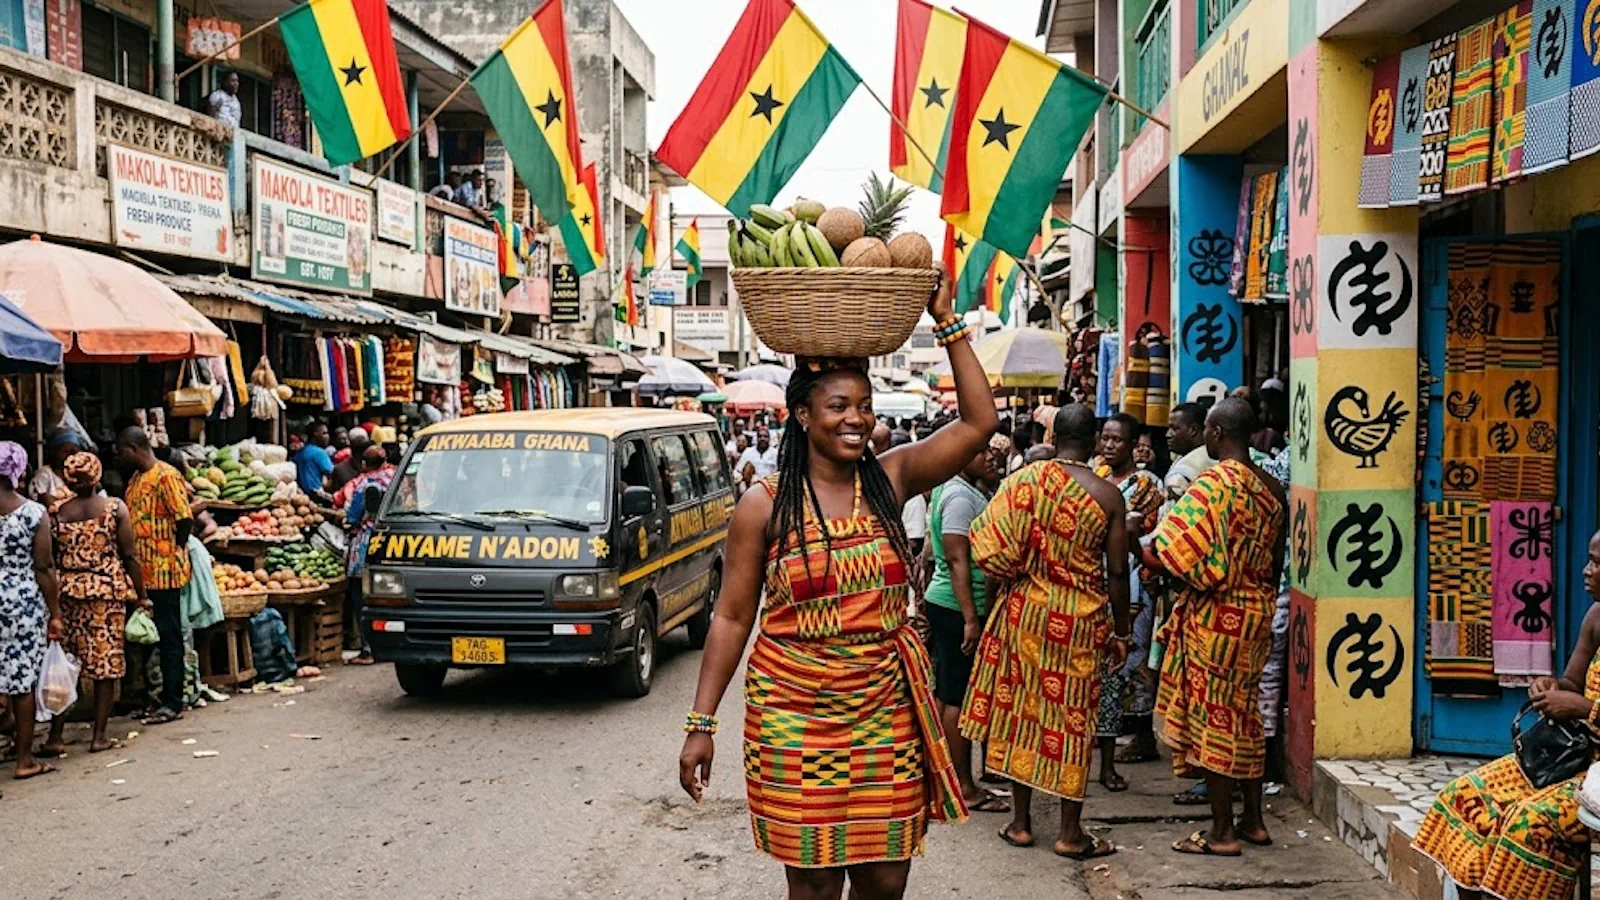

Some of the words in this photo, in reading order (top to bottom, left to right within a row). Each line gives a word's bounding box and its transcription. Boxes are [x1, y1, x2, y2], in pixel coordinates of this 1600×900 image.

[116, 152, 168, 189] MAKOLA
[170, 165, 224, 201] TEXTILES
[260, 168, 313, 208] MAKOLA
[317, 185, 368, 223] TEXTILES
[127, 206, 154, 225] FRESH
[423, 433, 515, 451] AKWAABA
[524, 433, 590, 451] GHANA
[386, 535, 472, 558] NYAME
[478, 536, 580, 560] N'ADOM
